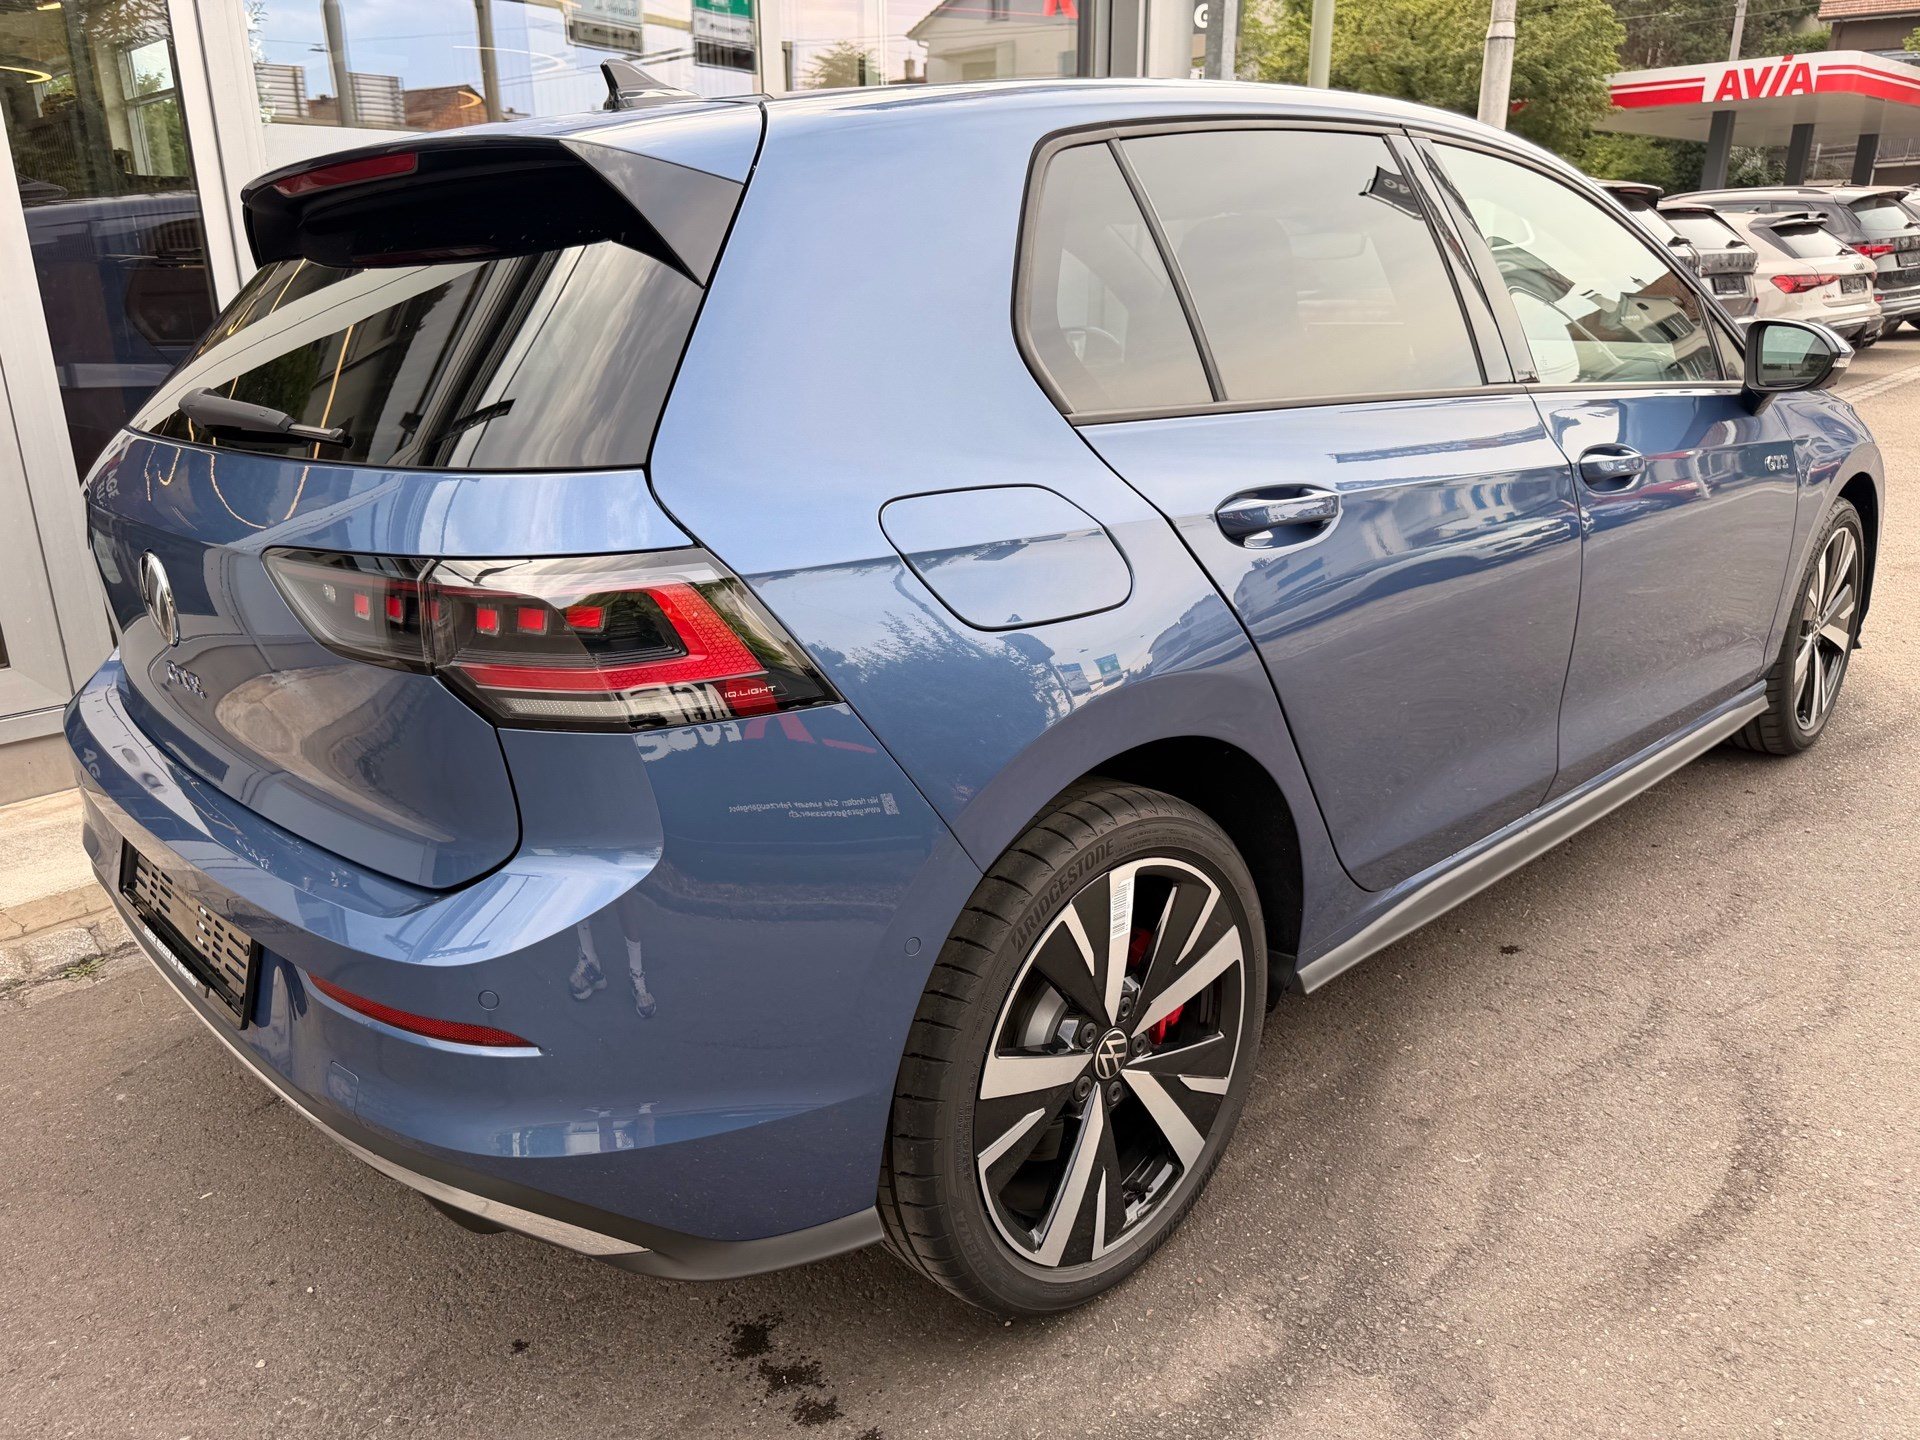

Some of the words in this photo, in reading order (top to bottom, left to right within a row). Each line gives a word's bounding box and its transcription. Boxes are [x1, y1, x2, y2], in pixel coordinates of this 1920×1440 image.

[1712, 54, 1814, 103] AVIA
[724, 685, 776, 698] IQ.LIGHT
[1010, 838, 1114, 954] BRIDGESTONE
